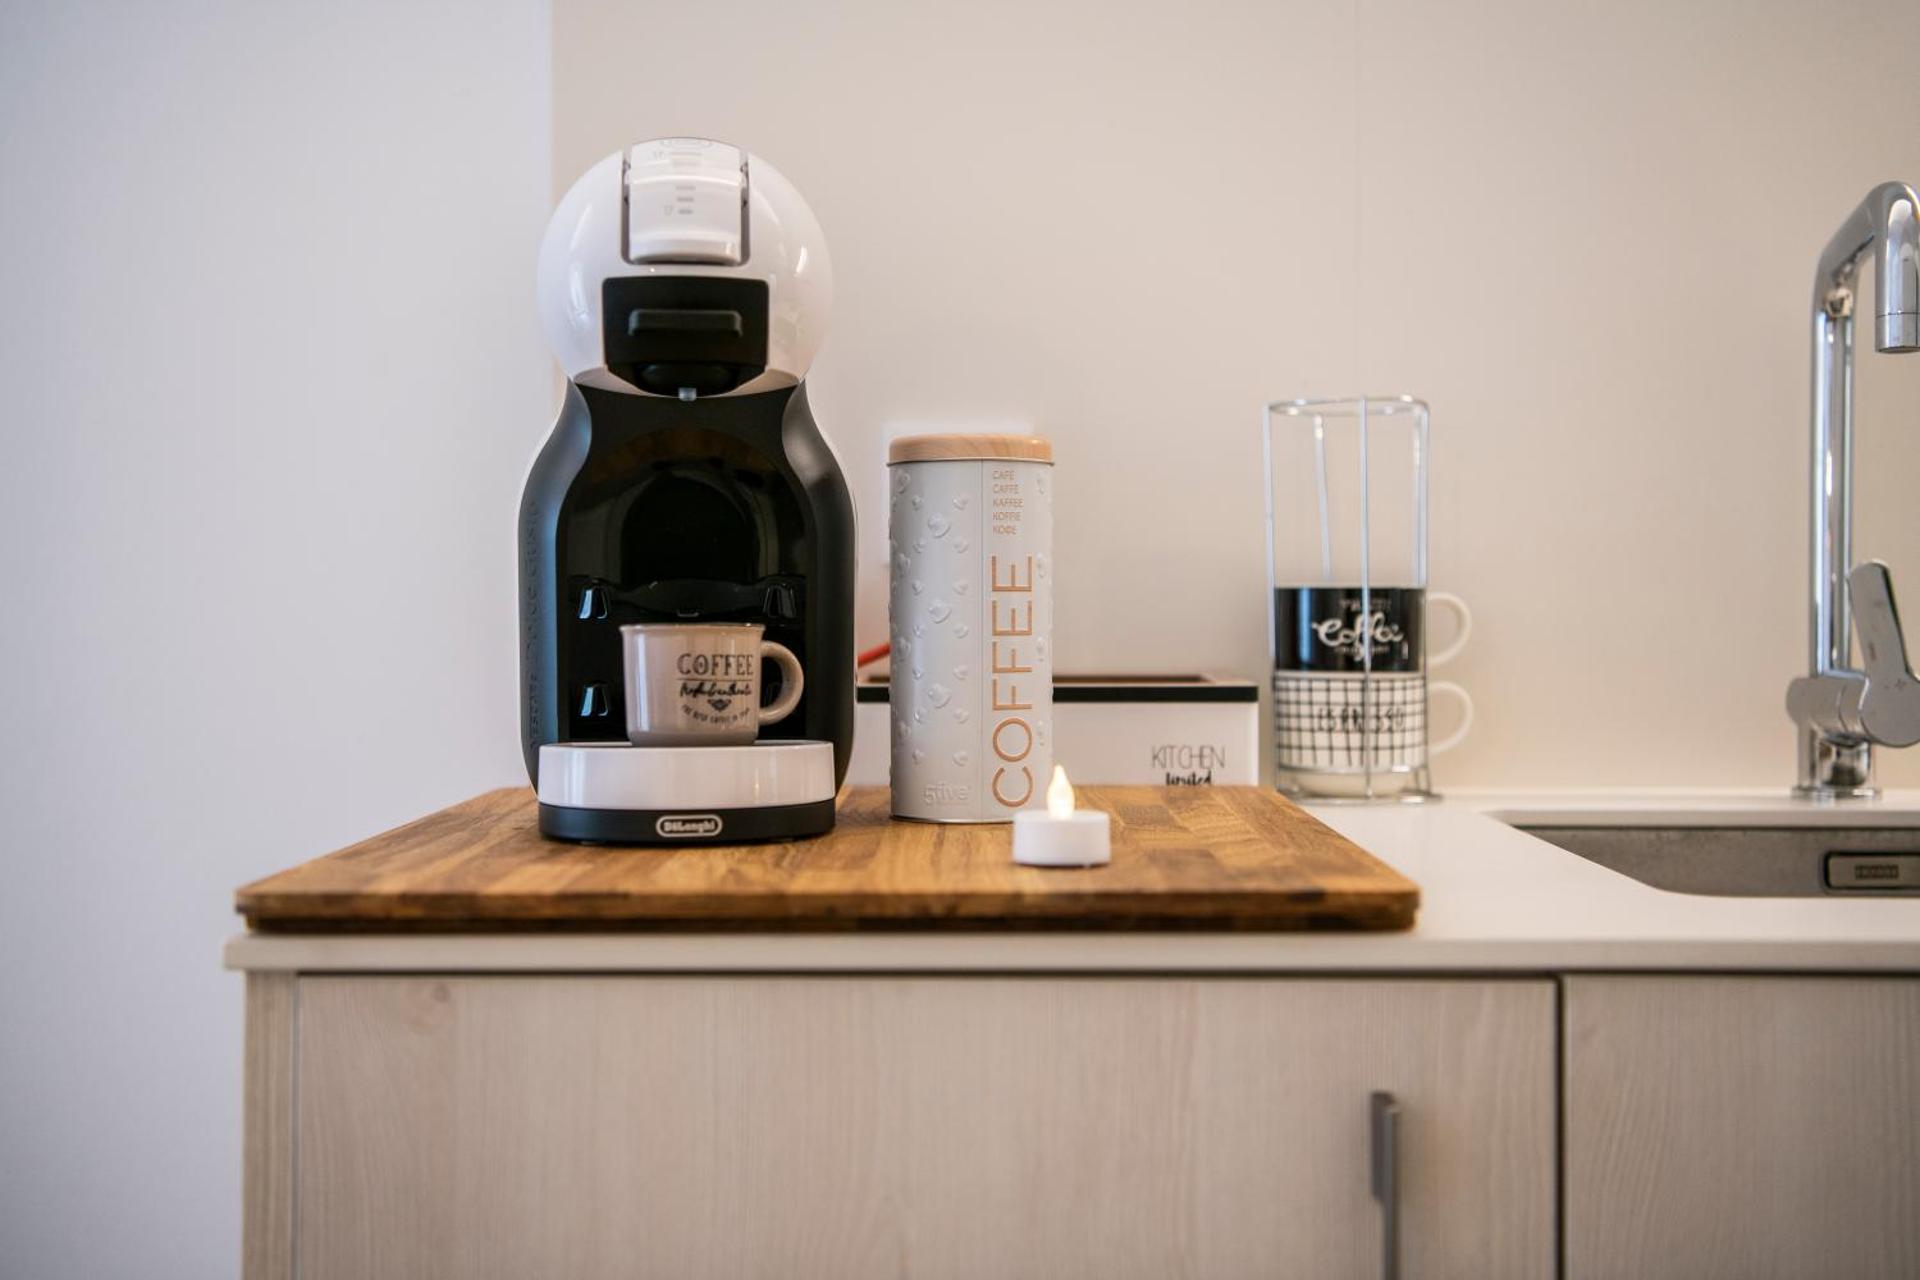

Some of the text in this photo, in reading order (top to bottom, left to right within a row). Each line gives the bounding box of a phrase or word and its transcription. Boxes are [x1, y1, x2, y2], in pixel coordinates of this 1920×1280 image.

[677, 653, 753, 676] COFFEE
[992, 556, 1033, 807] COFFEE
[1151, 744, 1224, 769] KITCHEN
